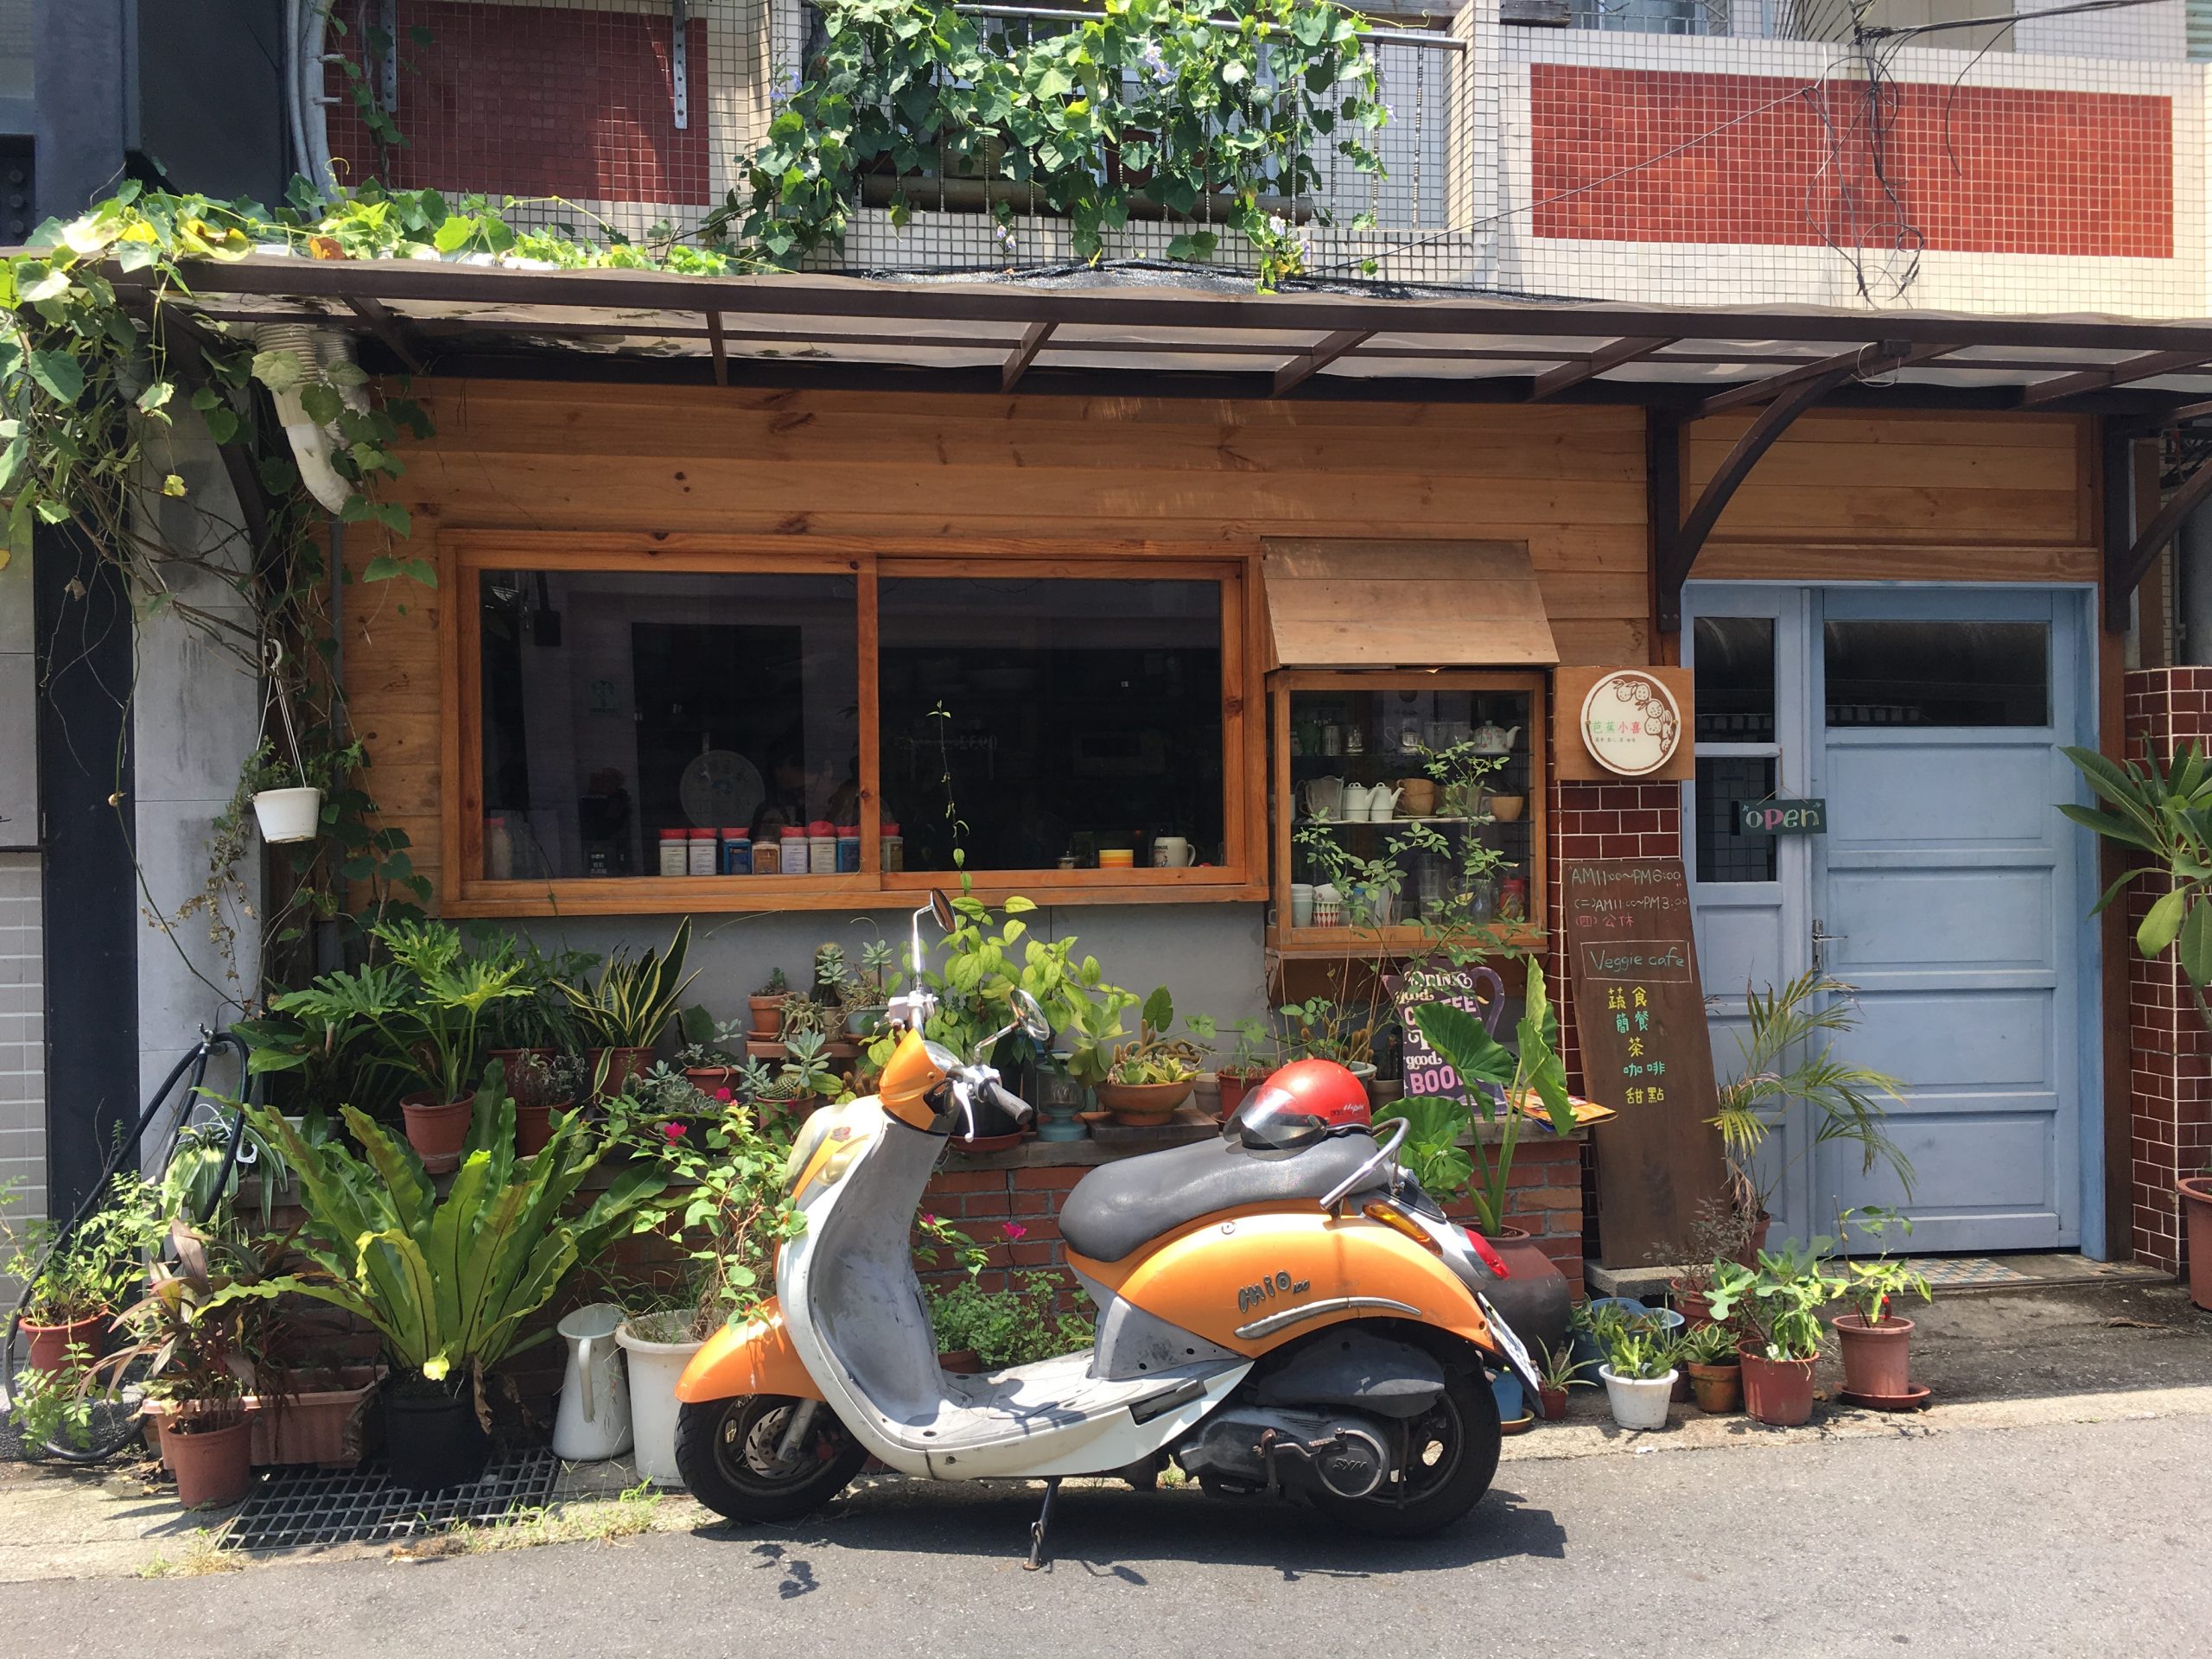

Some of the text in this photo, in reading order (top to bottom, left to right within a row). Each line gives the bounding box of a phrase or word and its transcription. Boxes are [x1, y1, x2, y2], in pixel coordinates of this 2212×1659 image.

[1745, 808, 1819, 830] open
[1590, 946, 1685, 972] Veggie cafe
[1608, 986, 1648, 1009] 蔬食
[1616, 1010, 1649, 1034] 簡餐
[1628, 1036, 1644, 1058] 茶
[1406, 1051, 1443, 1070] good
[1623, 1060, 1666, 1077] 咖啡
[1409, 1065, 1464, 1095] BOO
[1624, 1086, 1664, 1104] 甜點
